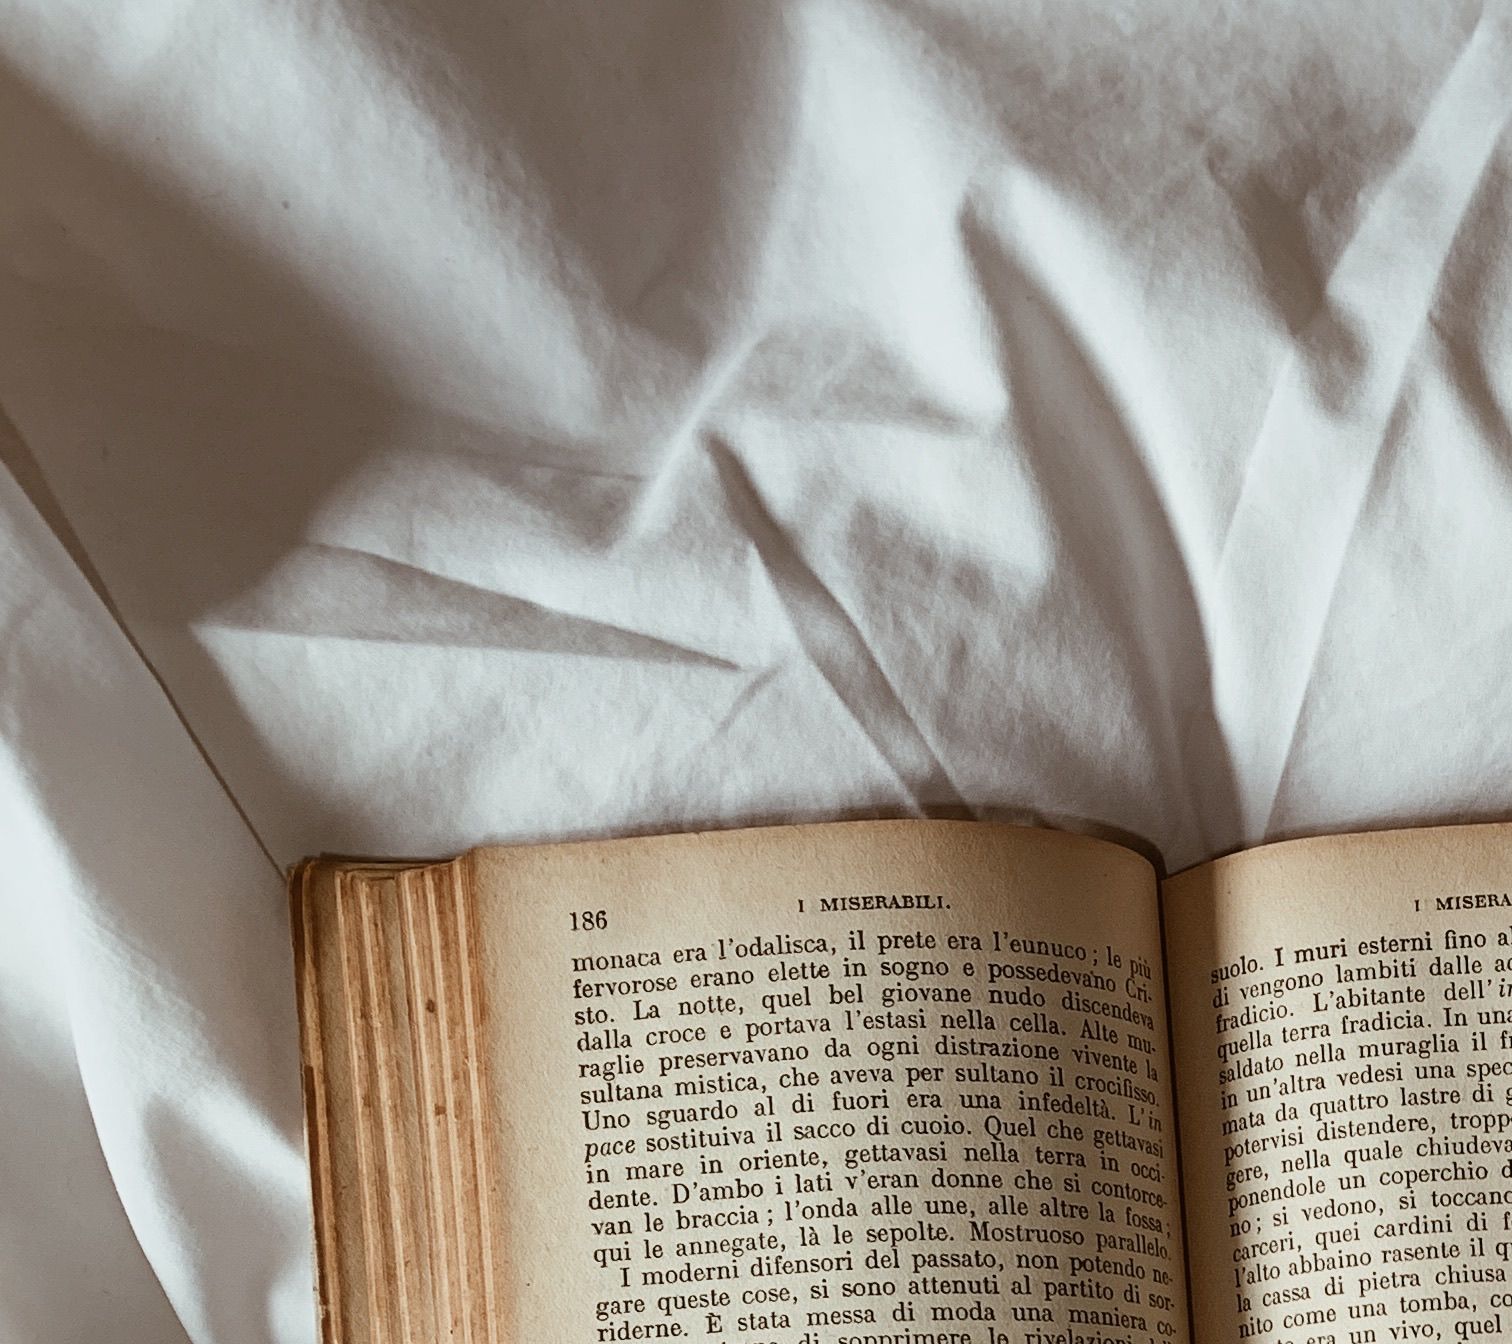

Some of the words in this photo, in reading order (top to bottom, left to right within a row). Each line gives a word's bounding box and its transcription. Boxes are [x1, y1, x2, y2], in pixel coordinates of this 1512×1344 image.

[570, 911, 607, 931] 186
[798, 900, 804, 912] I
[820, 895, 953, 913] MISERABILI.
[1415, 900, 1419, 911] I
[1211, 956, 1263, 984] suolo.
[1275, 947, 1284, 966] I
[1294, 939, 1347, 963] muri
[1359, 932, 1432, 955] esterni
[1445, 930, 1486, 949] fino
[575, 1007, 614, 1025] sto.
[633, 1000, 660, 1020] La
[678, 996, 743, 1015] notte,
[762, 987, 811, 1014] quel
[829, 984, 863, 1004] bel
[882, 982, 973, 1007] giovane
[988, 985, 1045, 1007] nudo
[1061, 990, 1154, 1030] discendeva
[578, 1029, 632, 1052] dalla
[647, 1028, 705, 1045] croce
[721, 1026, 731, 1039] e
[745, 1018, 831, 1042] portava
[845, 1009, 926, 1030] l'estasi
[940, 1009, 998, 1033] nella
[1007, 1013, 1066, 1036] cella.
[1080, 1019, 1118, 1044] Alte
[1127, 1034, 1155, 1054] mu-
[1218, 1030, 1272, 1064] quella
[1283, 1025, 1330, 1043] terra
[1342, 1010, 1431, 1034] fradicia.
[1443, 1008, 1467, 1026] In
